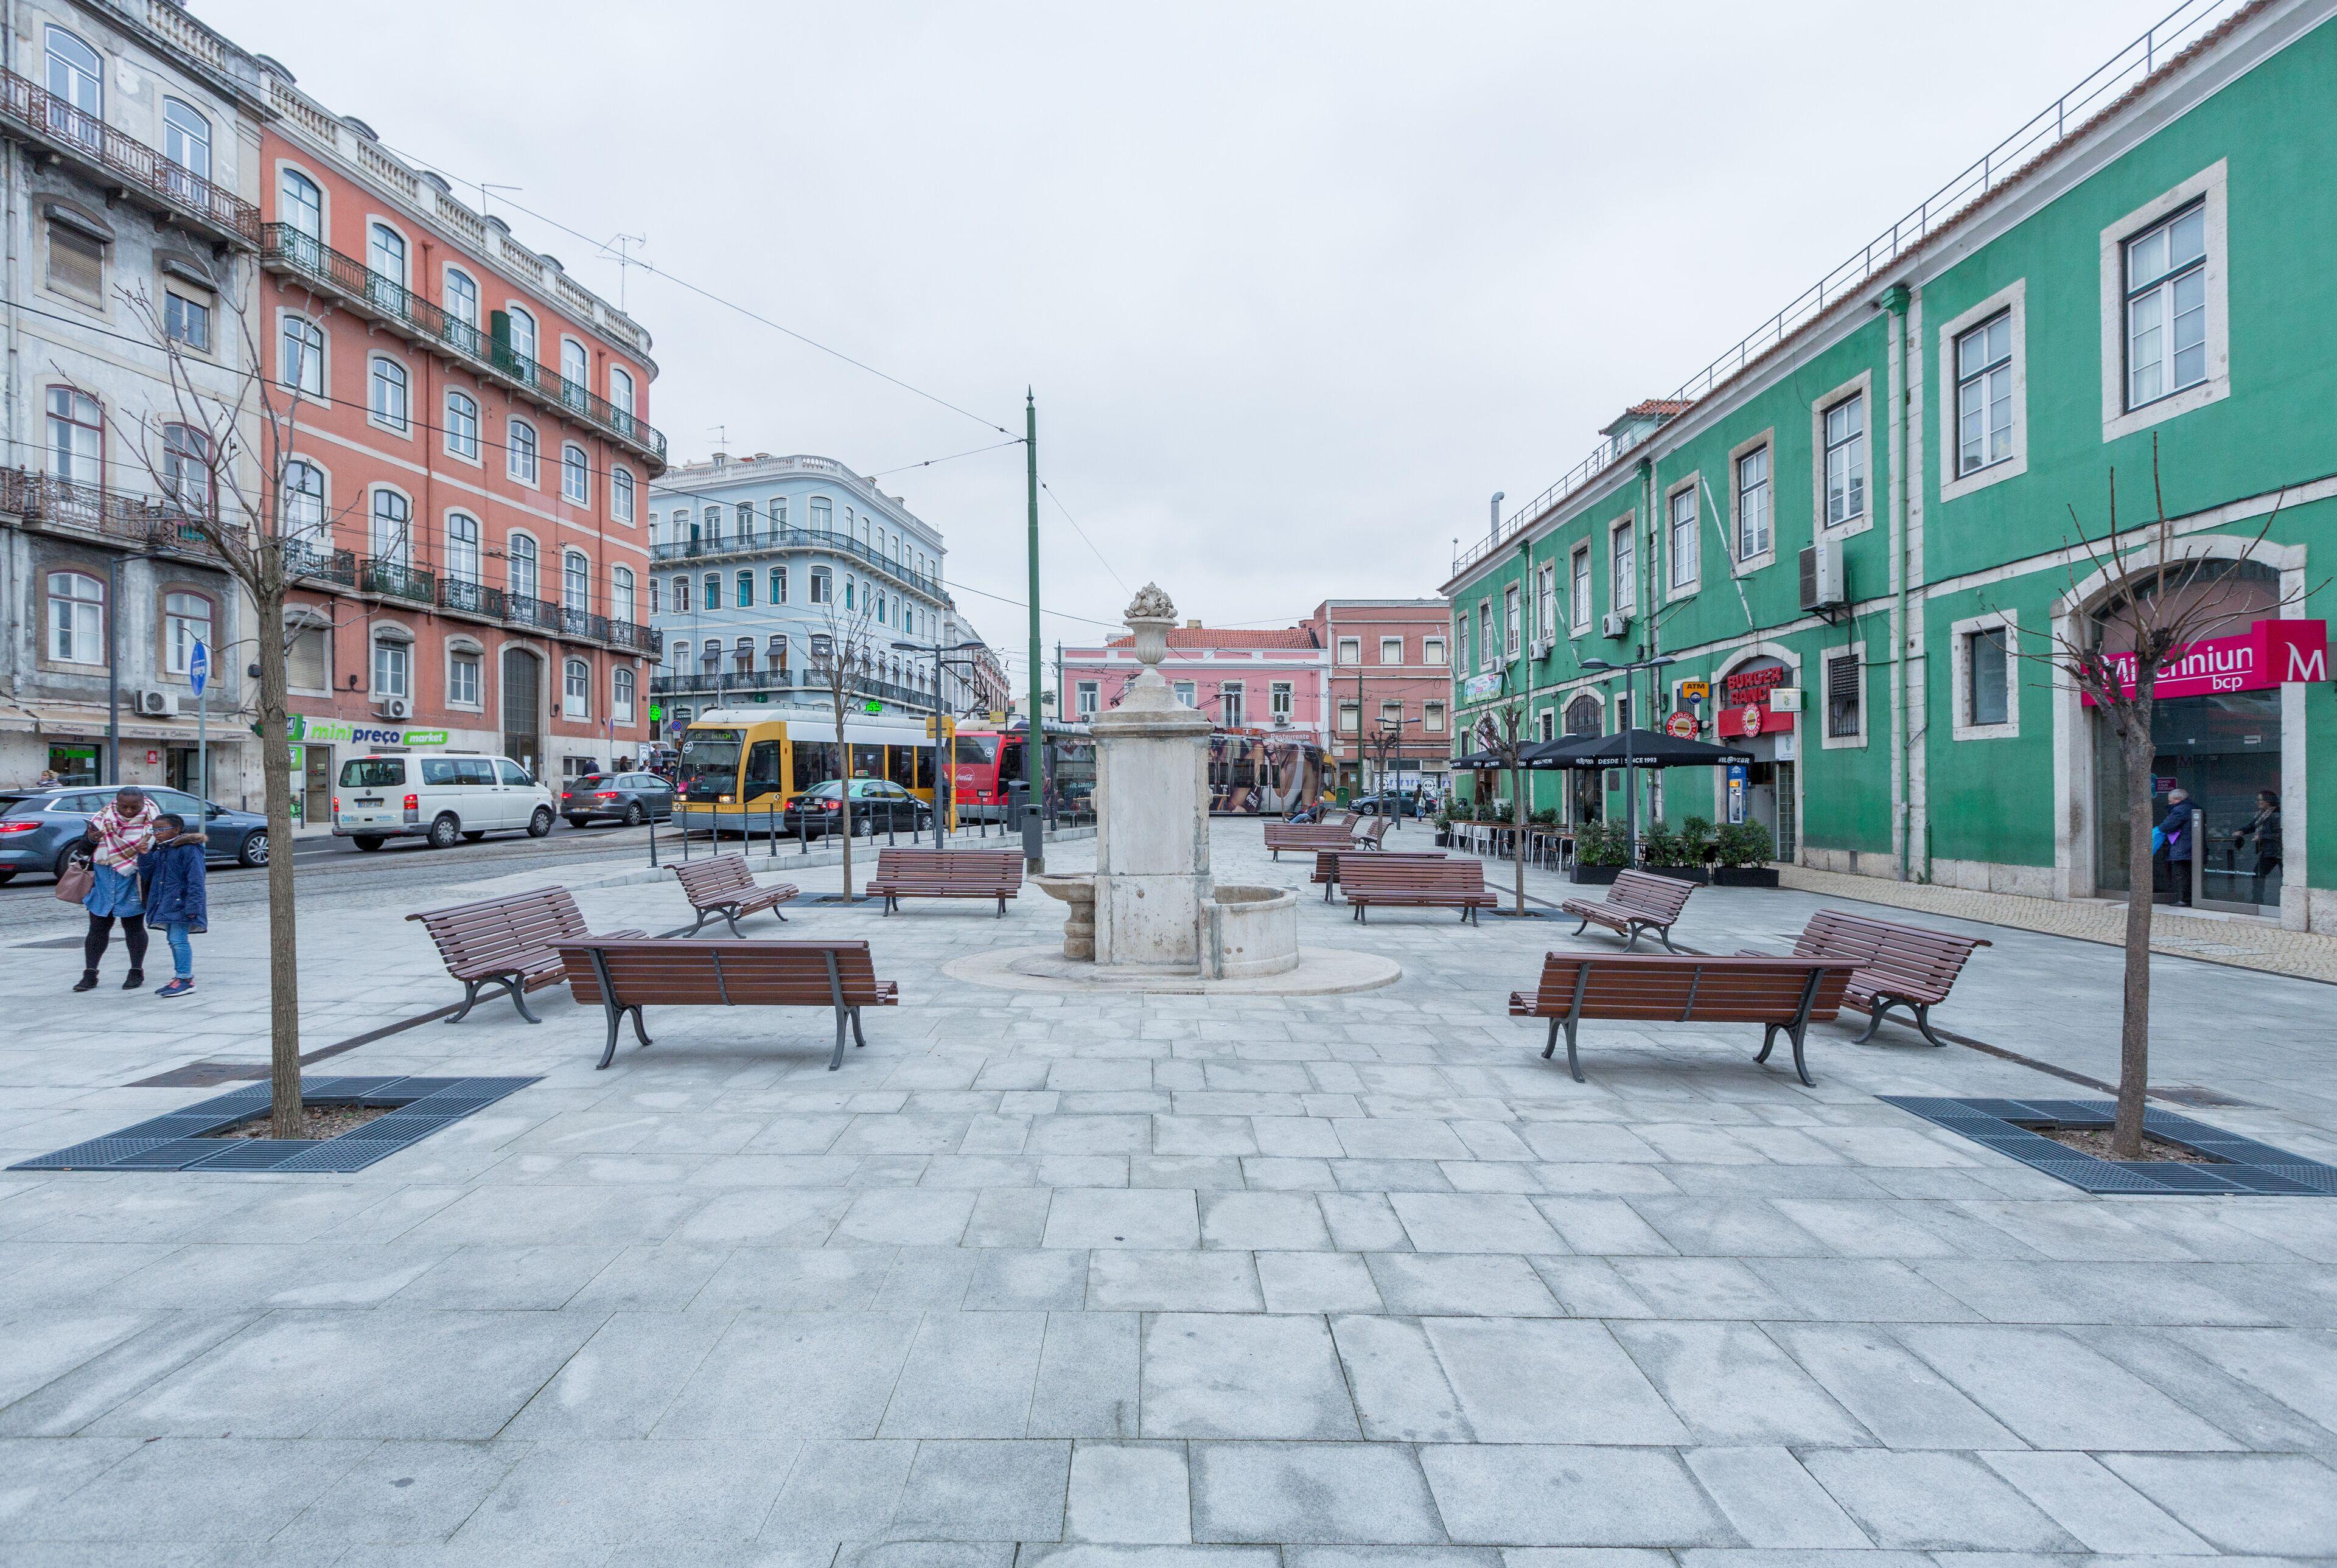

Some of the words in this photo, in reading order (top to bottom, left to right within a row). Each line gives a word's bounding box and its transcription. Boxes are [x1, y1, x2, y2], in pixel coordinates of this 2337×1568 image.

[2284, 642, 2327, 681] M
[1727, 666, 1783, 690] BURGER
[2212, 675, 2243, 691] bcp
[1668, 713, 1696, 728] BURGER
[310, 723, 400, 744] minipreço
[409, 733, 444, 742] market
